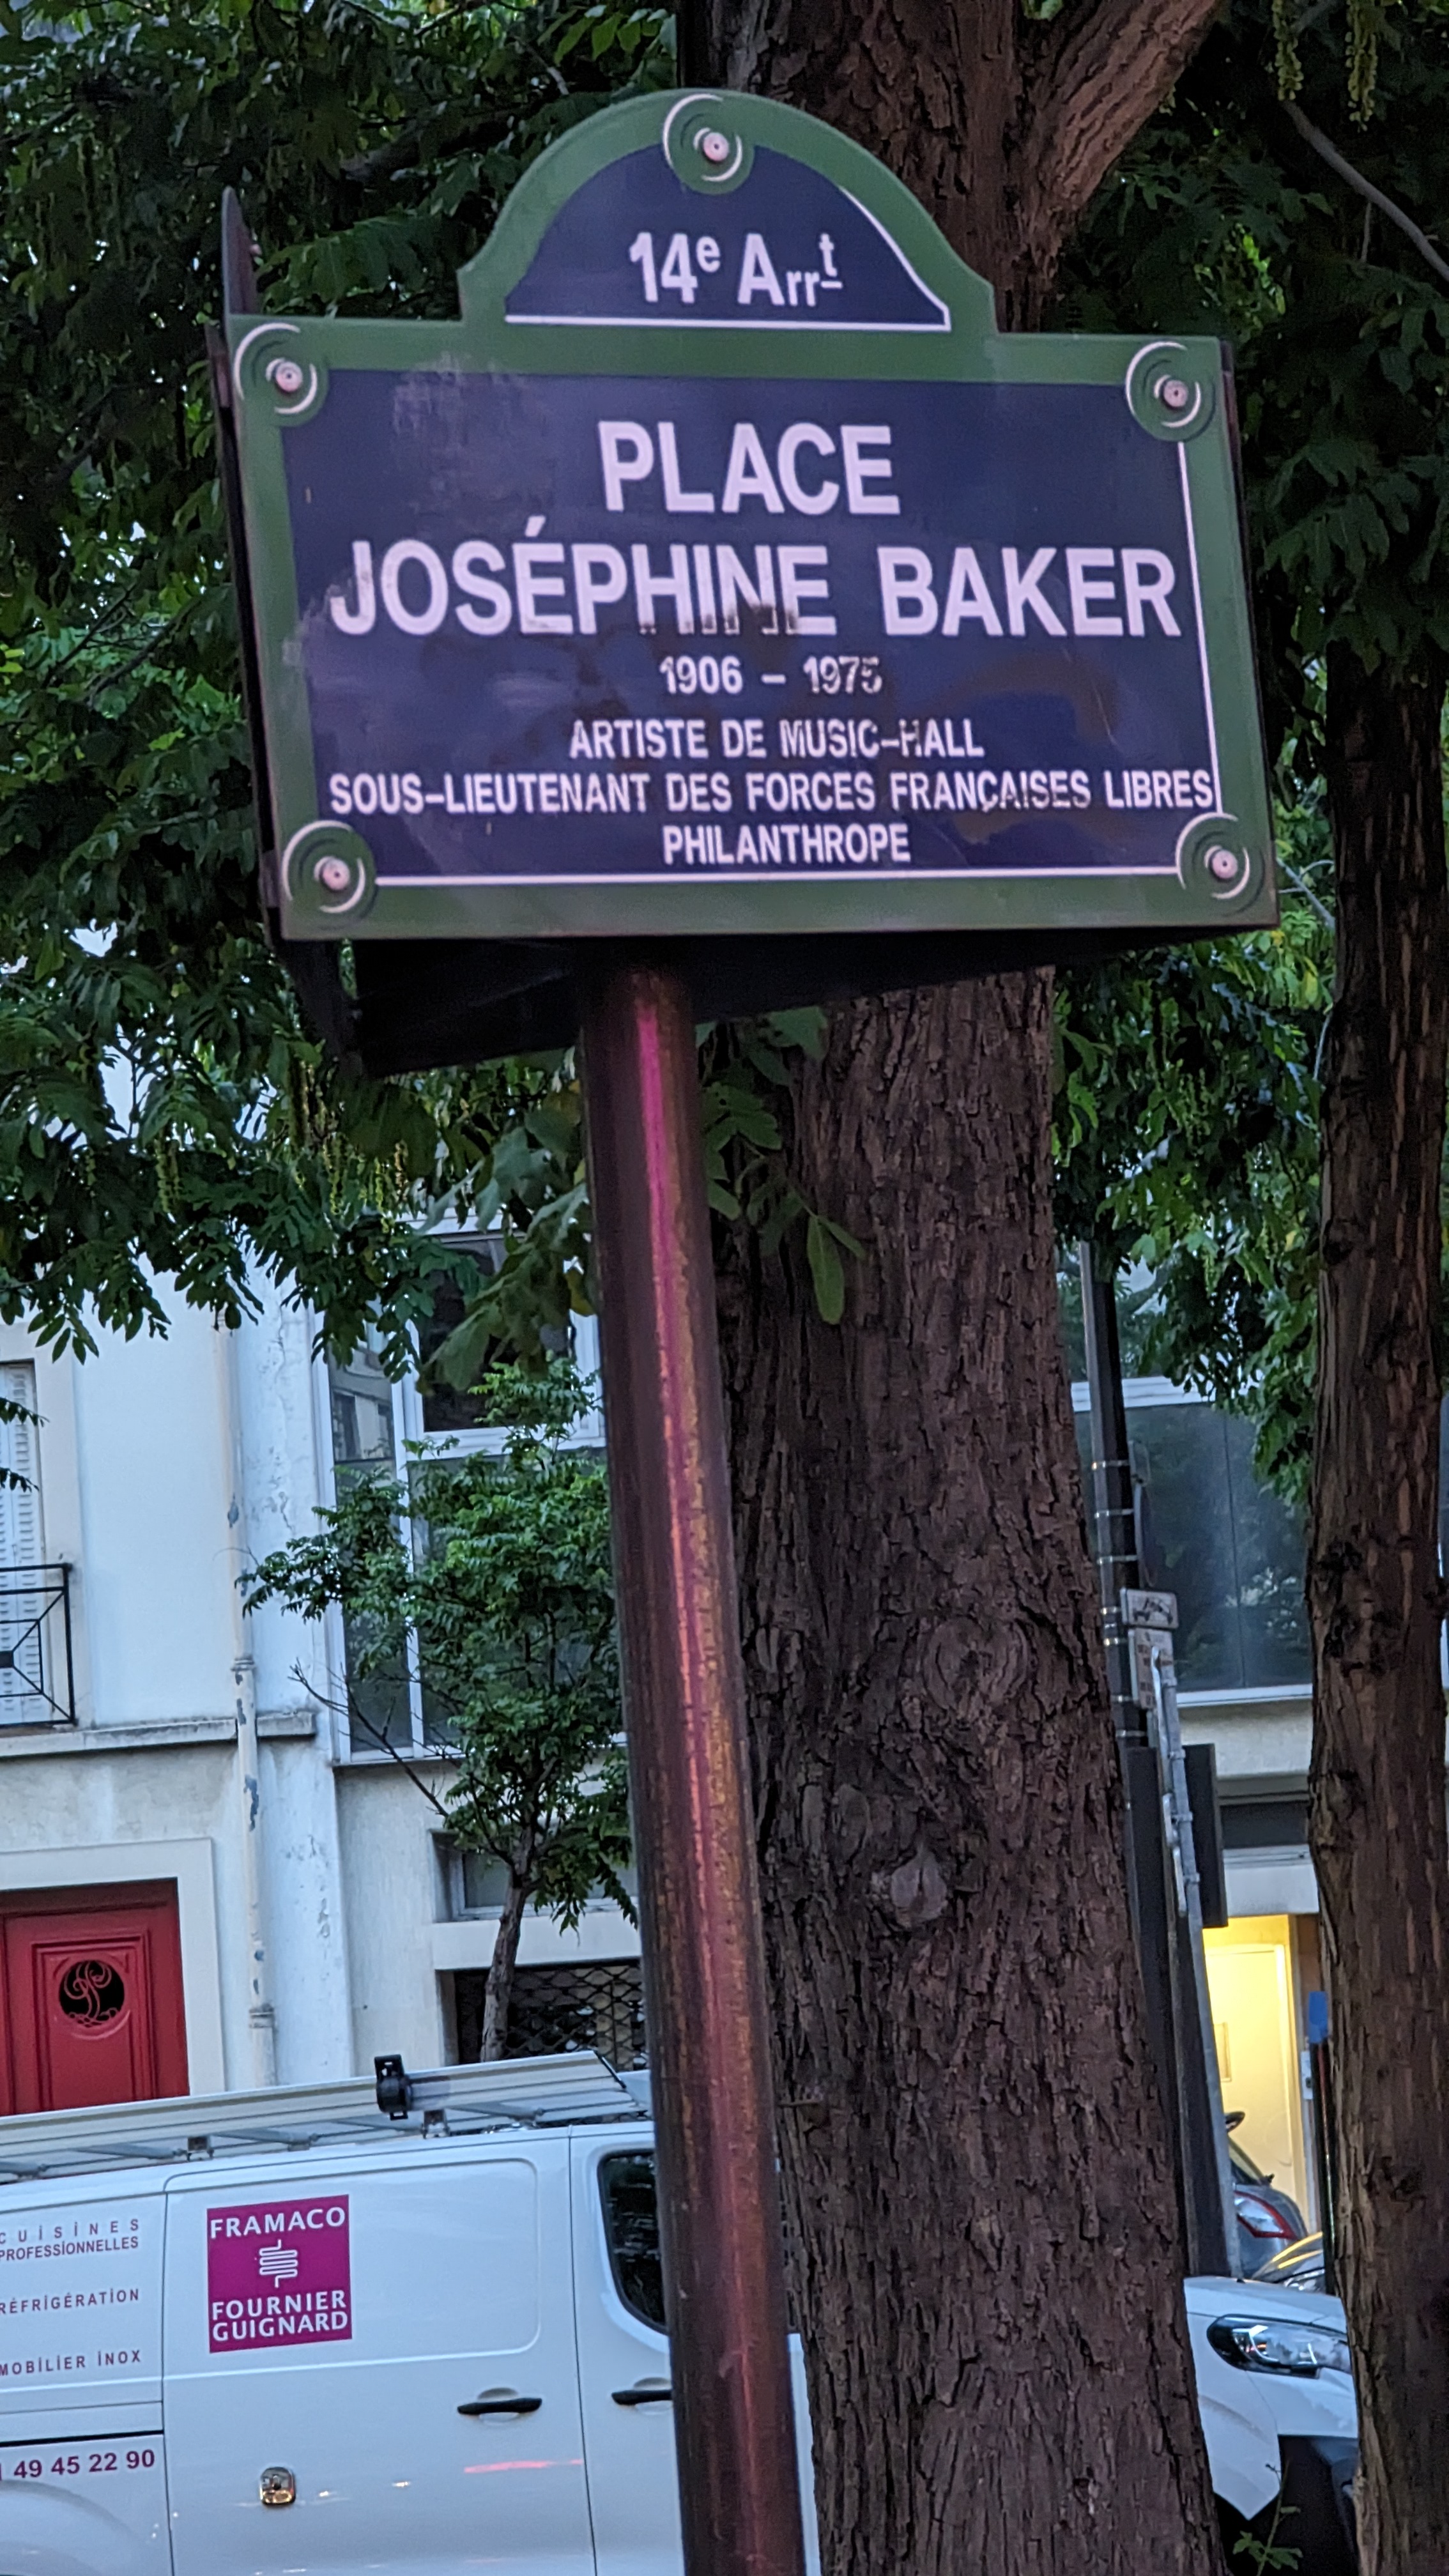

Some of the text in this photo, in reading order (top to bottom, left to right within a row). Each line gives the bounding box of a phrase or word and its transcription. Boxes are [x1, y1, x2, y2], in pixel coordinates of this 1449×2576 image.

[629, 232, 721, 303] 14e
[597, 420, 901, 515] PLACE
[329, 515, 1182, 636] JOSÉPHINE BAKER
[659, 656, 743, 694] 1906
[803, 656, 883, 694] 1975
[569, 719, 985, 760] ARTISTE DE MUSIC-HALL
[329, 769, 1214, 815] SOUS-LIEUTENANT DES FORCES FRANÇAISES LIBRES
[662, 823, 912, 865] PHILANTHROPE
[210, 2207, 346, 2239] FRAMACO
[212, 2290, 347, 2320] FOURNIER
[213, 2311, 348, 2342] GUIGNARD
[13, 2459, 42, 2478] 49
[51, 2456, 80, 2475] 45
[89, 2452, 118, 2472] 22
[126, 2449, 155, 2469] 90
